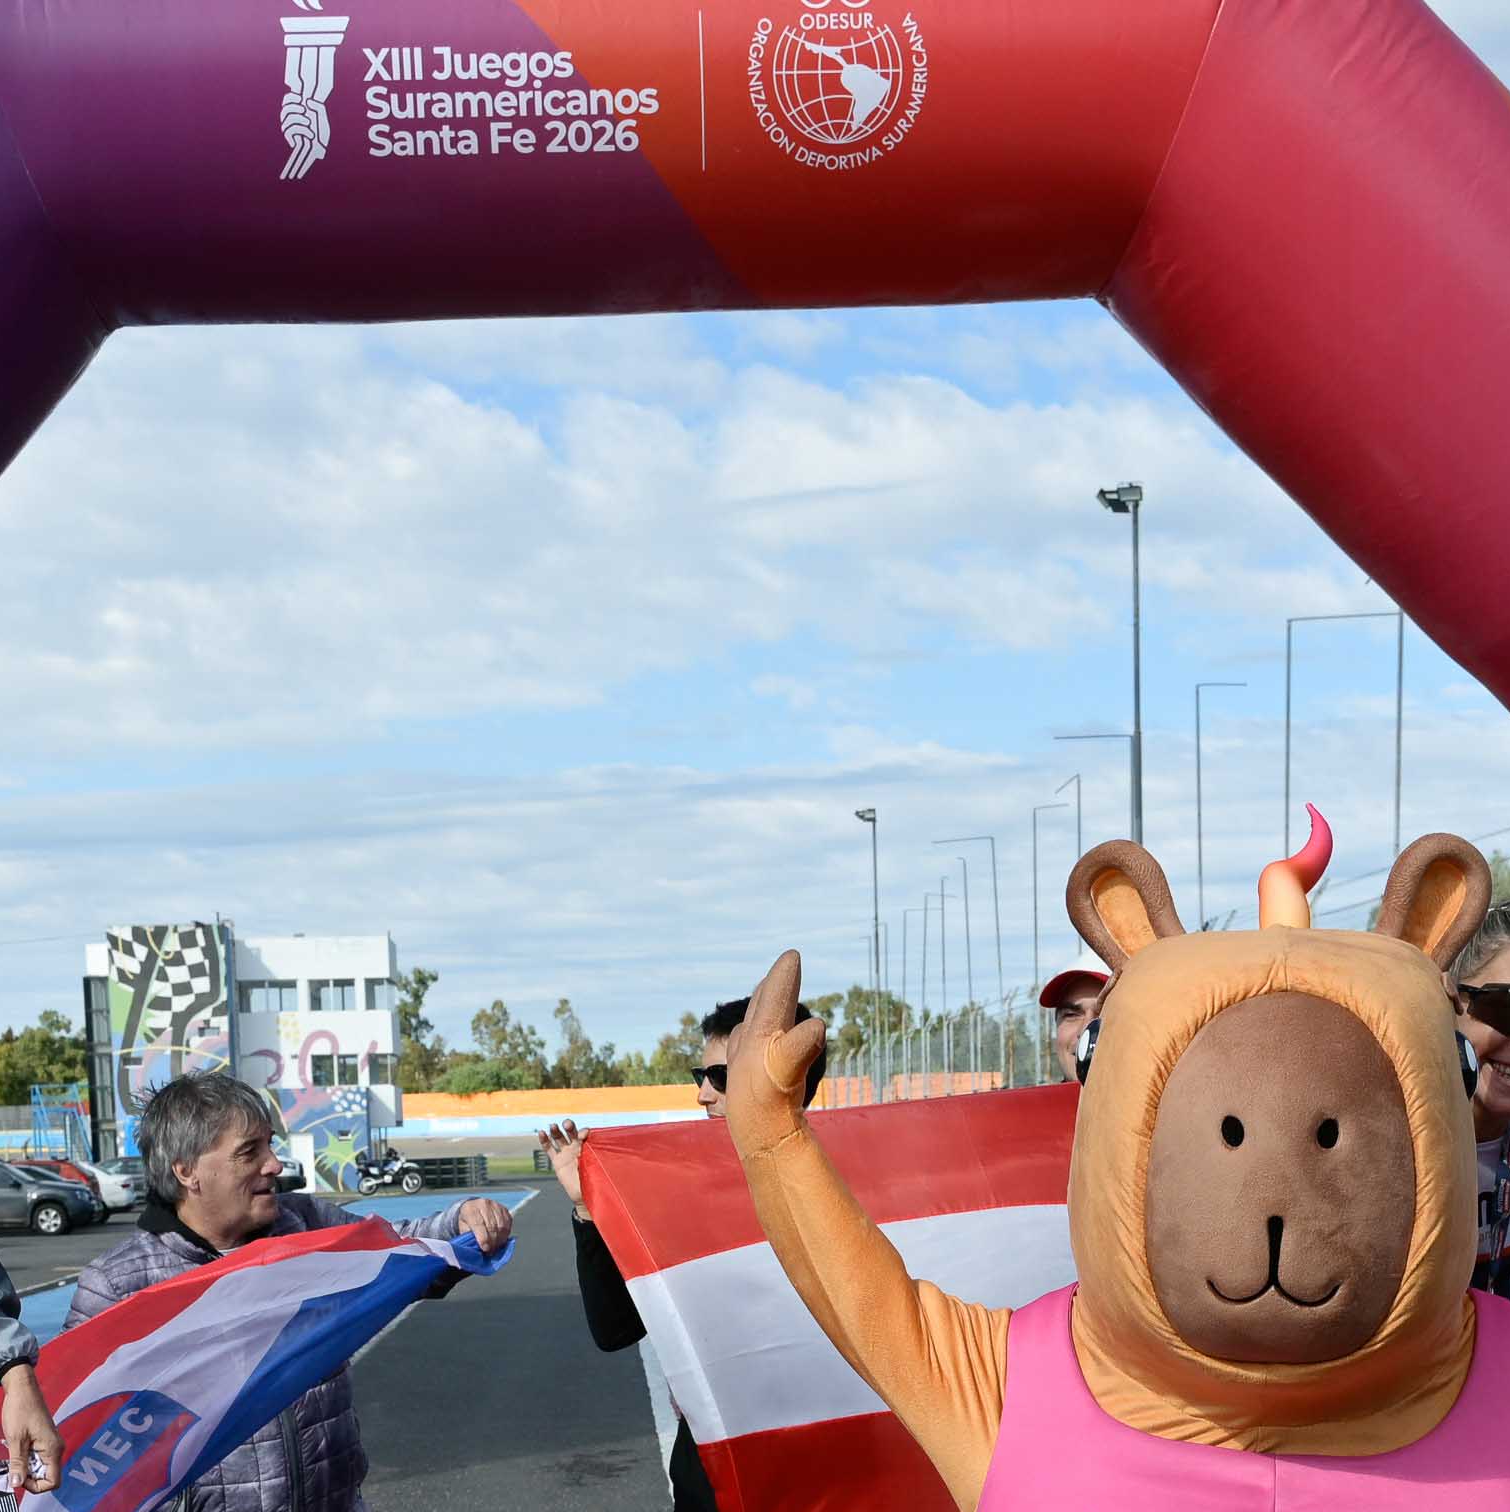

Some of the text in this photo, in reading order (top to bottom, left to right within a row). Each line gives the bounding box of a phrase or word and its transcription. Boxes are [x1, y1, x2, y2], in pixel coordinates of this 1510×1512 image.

[799, 12, 874, 31] ODESUR
[363, 44, 574, 88] XIII Juegos
[366, 79, 660, 121] Suramericanos
[747, 12, 928, 170] ORGANIZACION DEPORTIVA SURAMERICANA
[367, 119, 640, 157] Santa Fe 2026
